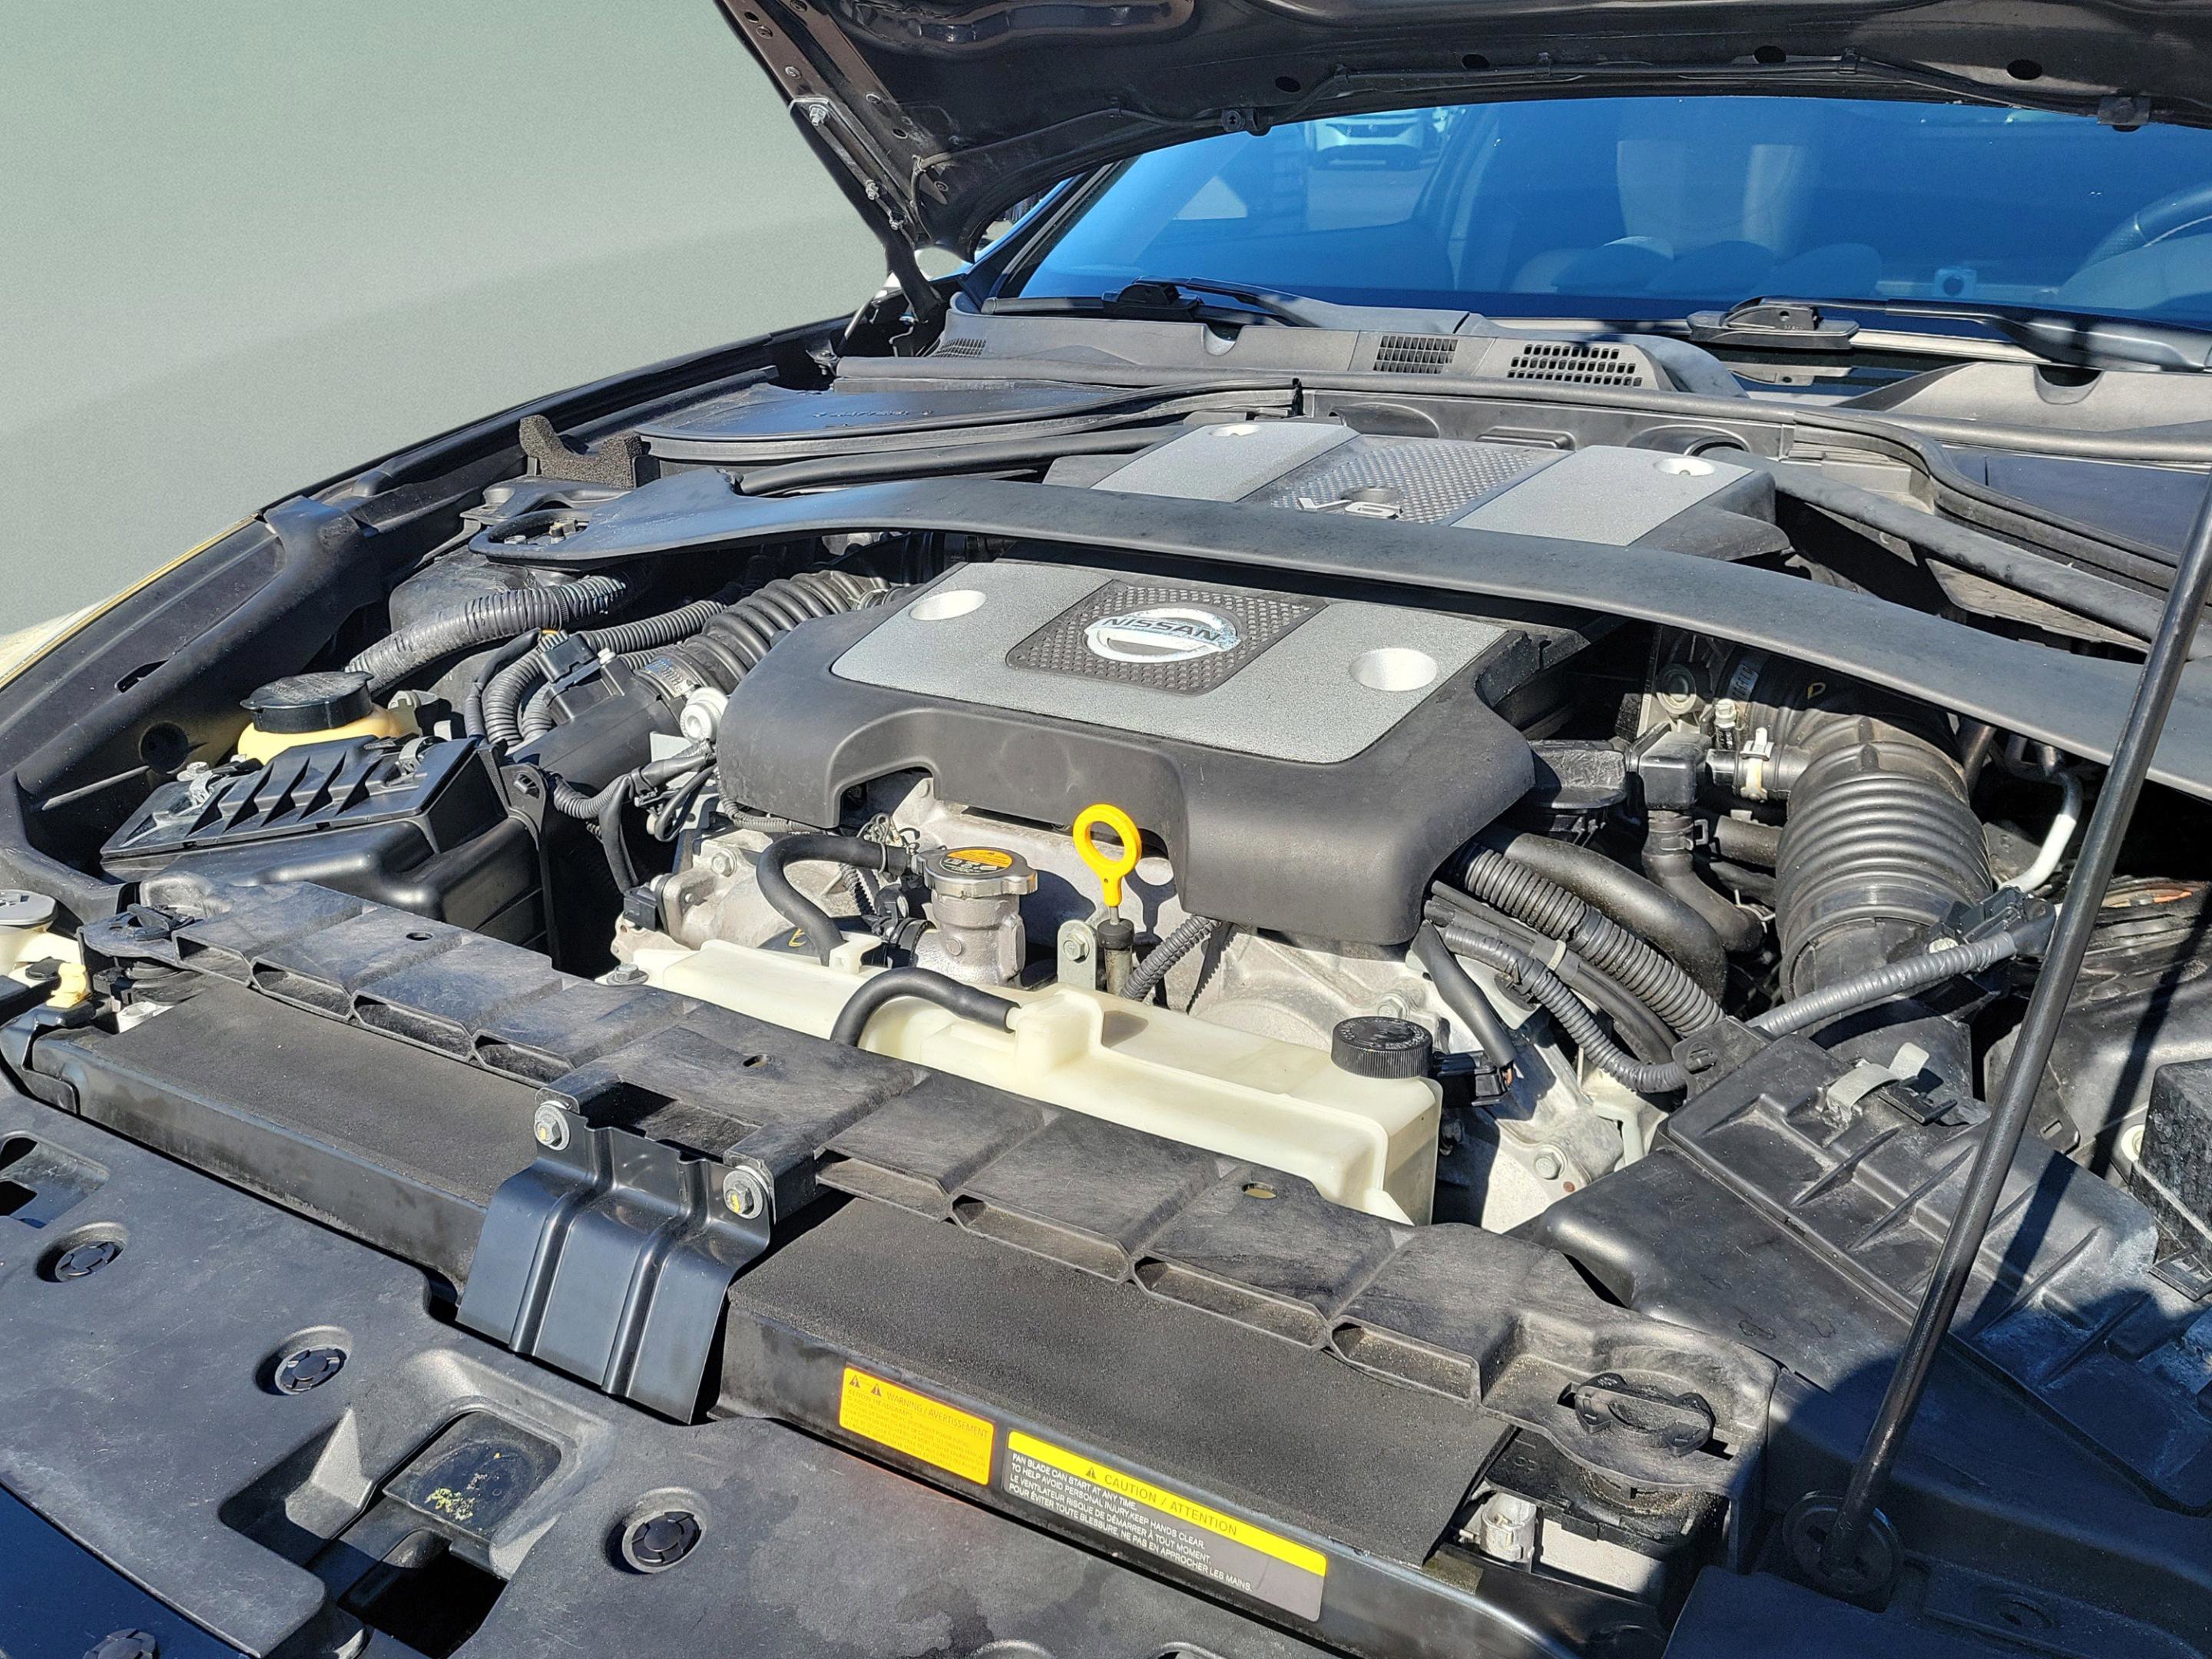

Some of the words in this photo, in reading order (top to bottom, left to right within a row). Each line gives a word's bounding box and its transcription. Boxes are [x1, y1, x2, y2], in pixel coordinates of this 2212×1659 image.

[1101, 618, 1221, 641] NISSAN
[886, 1391, 922, 1412] WARNING
[928, 1409, 988, 1439] AVERTISSEMENT
[1011, 1462, 1022, 1473] TO
[1022, 1467, 1041, 1480] HELP
[1041, 1475, 1064, 1490] AVOID
[1064, 1485, 1104, 1508] PERSONAL
[1150, 1520, 1177, 1538] HANDS
[1178, 1532, 1205, 1550] CLEAR.
[1012, 1452, 1026, 1465] FAN
[1027, 1459, 1051, 1475] BLADE
[1051, 1469, 1068, 1482] CAN
[1068, 1476, 1091, 1492] START
[1091, 1485, 1101, 1495] AT
[1101, 1490, 1118, 1502] ANY
[1119, 1497, 1137, 1512] TIME.
[1104, 1474, 1157, 1503] CAUTION
[1170, 1502, 1237, 1537] ATTENTION
[1008, 1482, 1030, 1498] POUR
[1030, 1490, 1055, 1509] ÉVITER
[1055, 1502, 1079, 1518] TOUTE
[1079, 1512, 1119, 1538] BLESSURE,
[1121, 1529, 1131, 1541] NE
[1132, 1534, 1147, 1548] PAS
[1148, 1541, 1160, 1553] EN
[1160, 1546, 1209, 1574] APPROCHER
[1209, 1567, 1224, 1580] LES
[1225, 1573, 1253, 1592] MAINS.
[1010, 1472, 1019, 1484] LE
[1020, 1476, 1065, 1503] VENTILATEUR
[1094, 1508, 1105, 1520] DE
[1106, 1513, 1147, 1538] DÉMARRER
[1147, 1528, 1154, 1540] À
[1155, 1533, 1175, 1548] TOUT
[1176, 1542, 1211, 1565] MOMENT.
